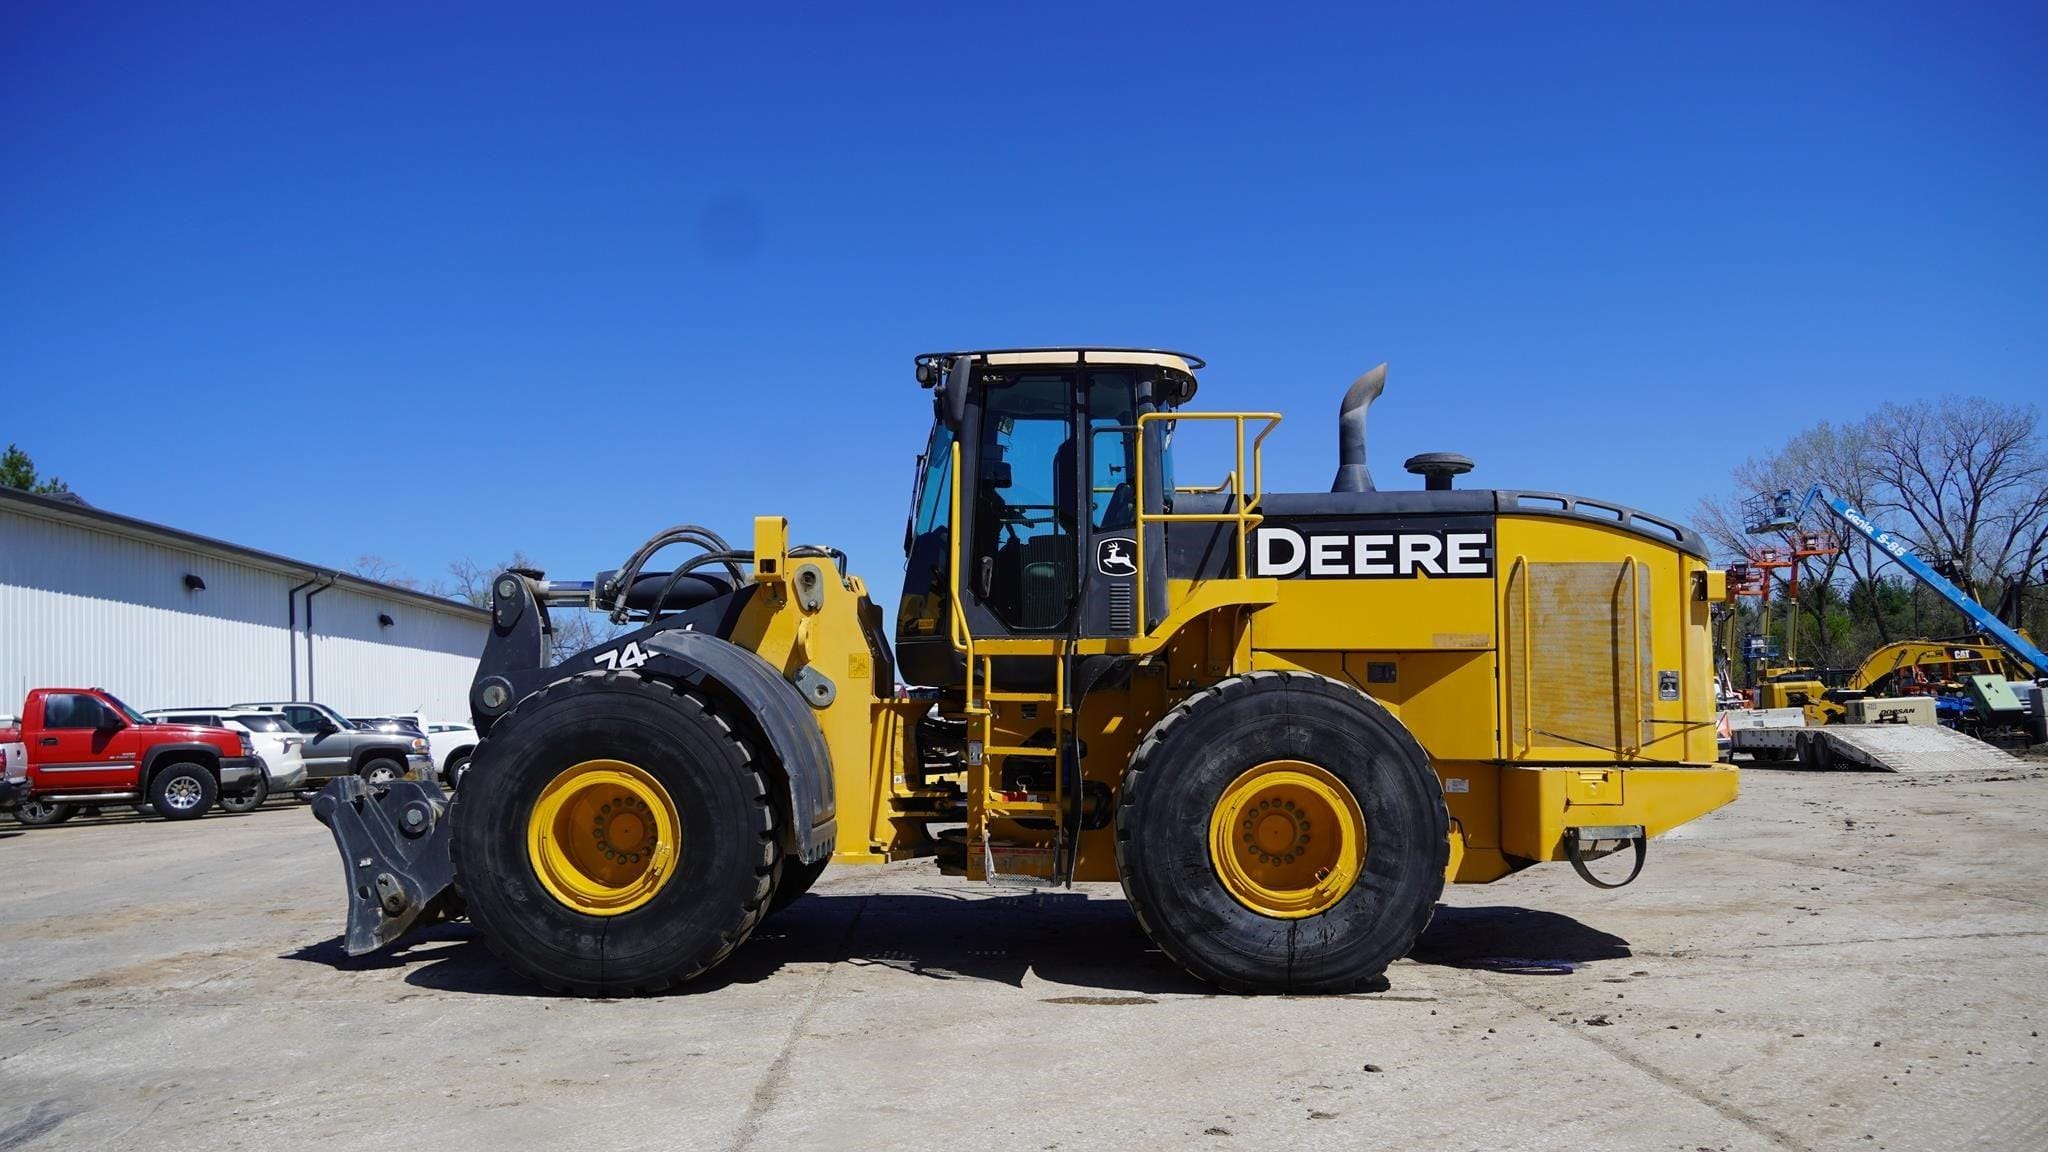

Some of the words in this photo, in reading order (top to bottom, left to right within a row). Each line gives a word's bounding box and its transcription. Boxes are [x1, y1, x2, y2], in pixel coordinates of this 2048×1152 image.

[1257, 527, 1488, 576] DEERE
[1845, 508, 1874, 534] Genie
[1876, 533, 1907, 556] S-85
[593, 623, 693, 670] 74
[1954, 649, 1970, 659] CAT
